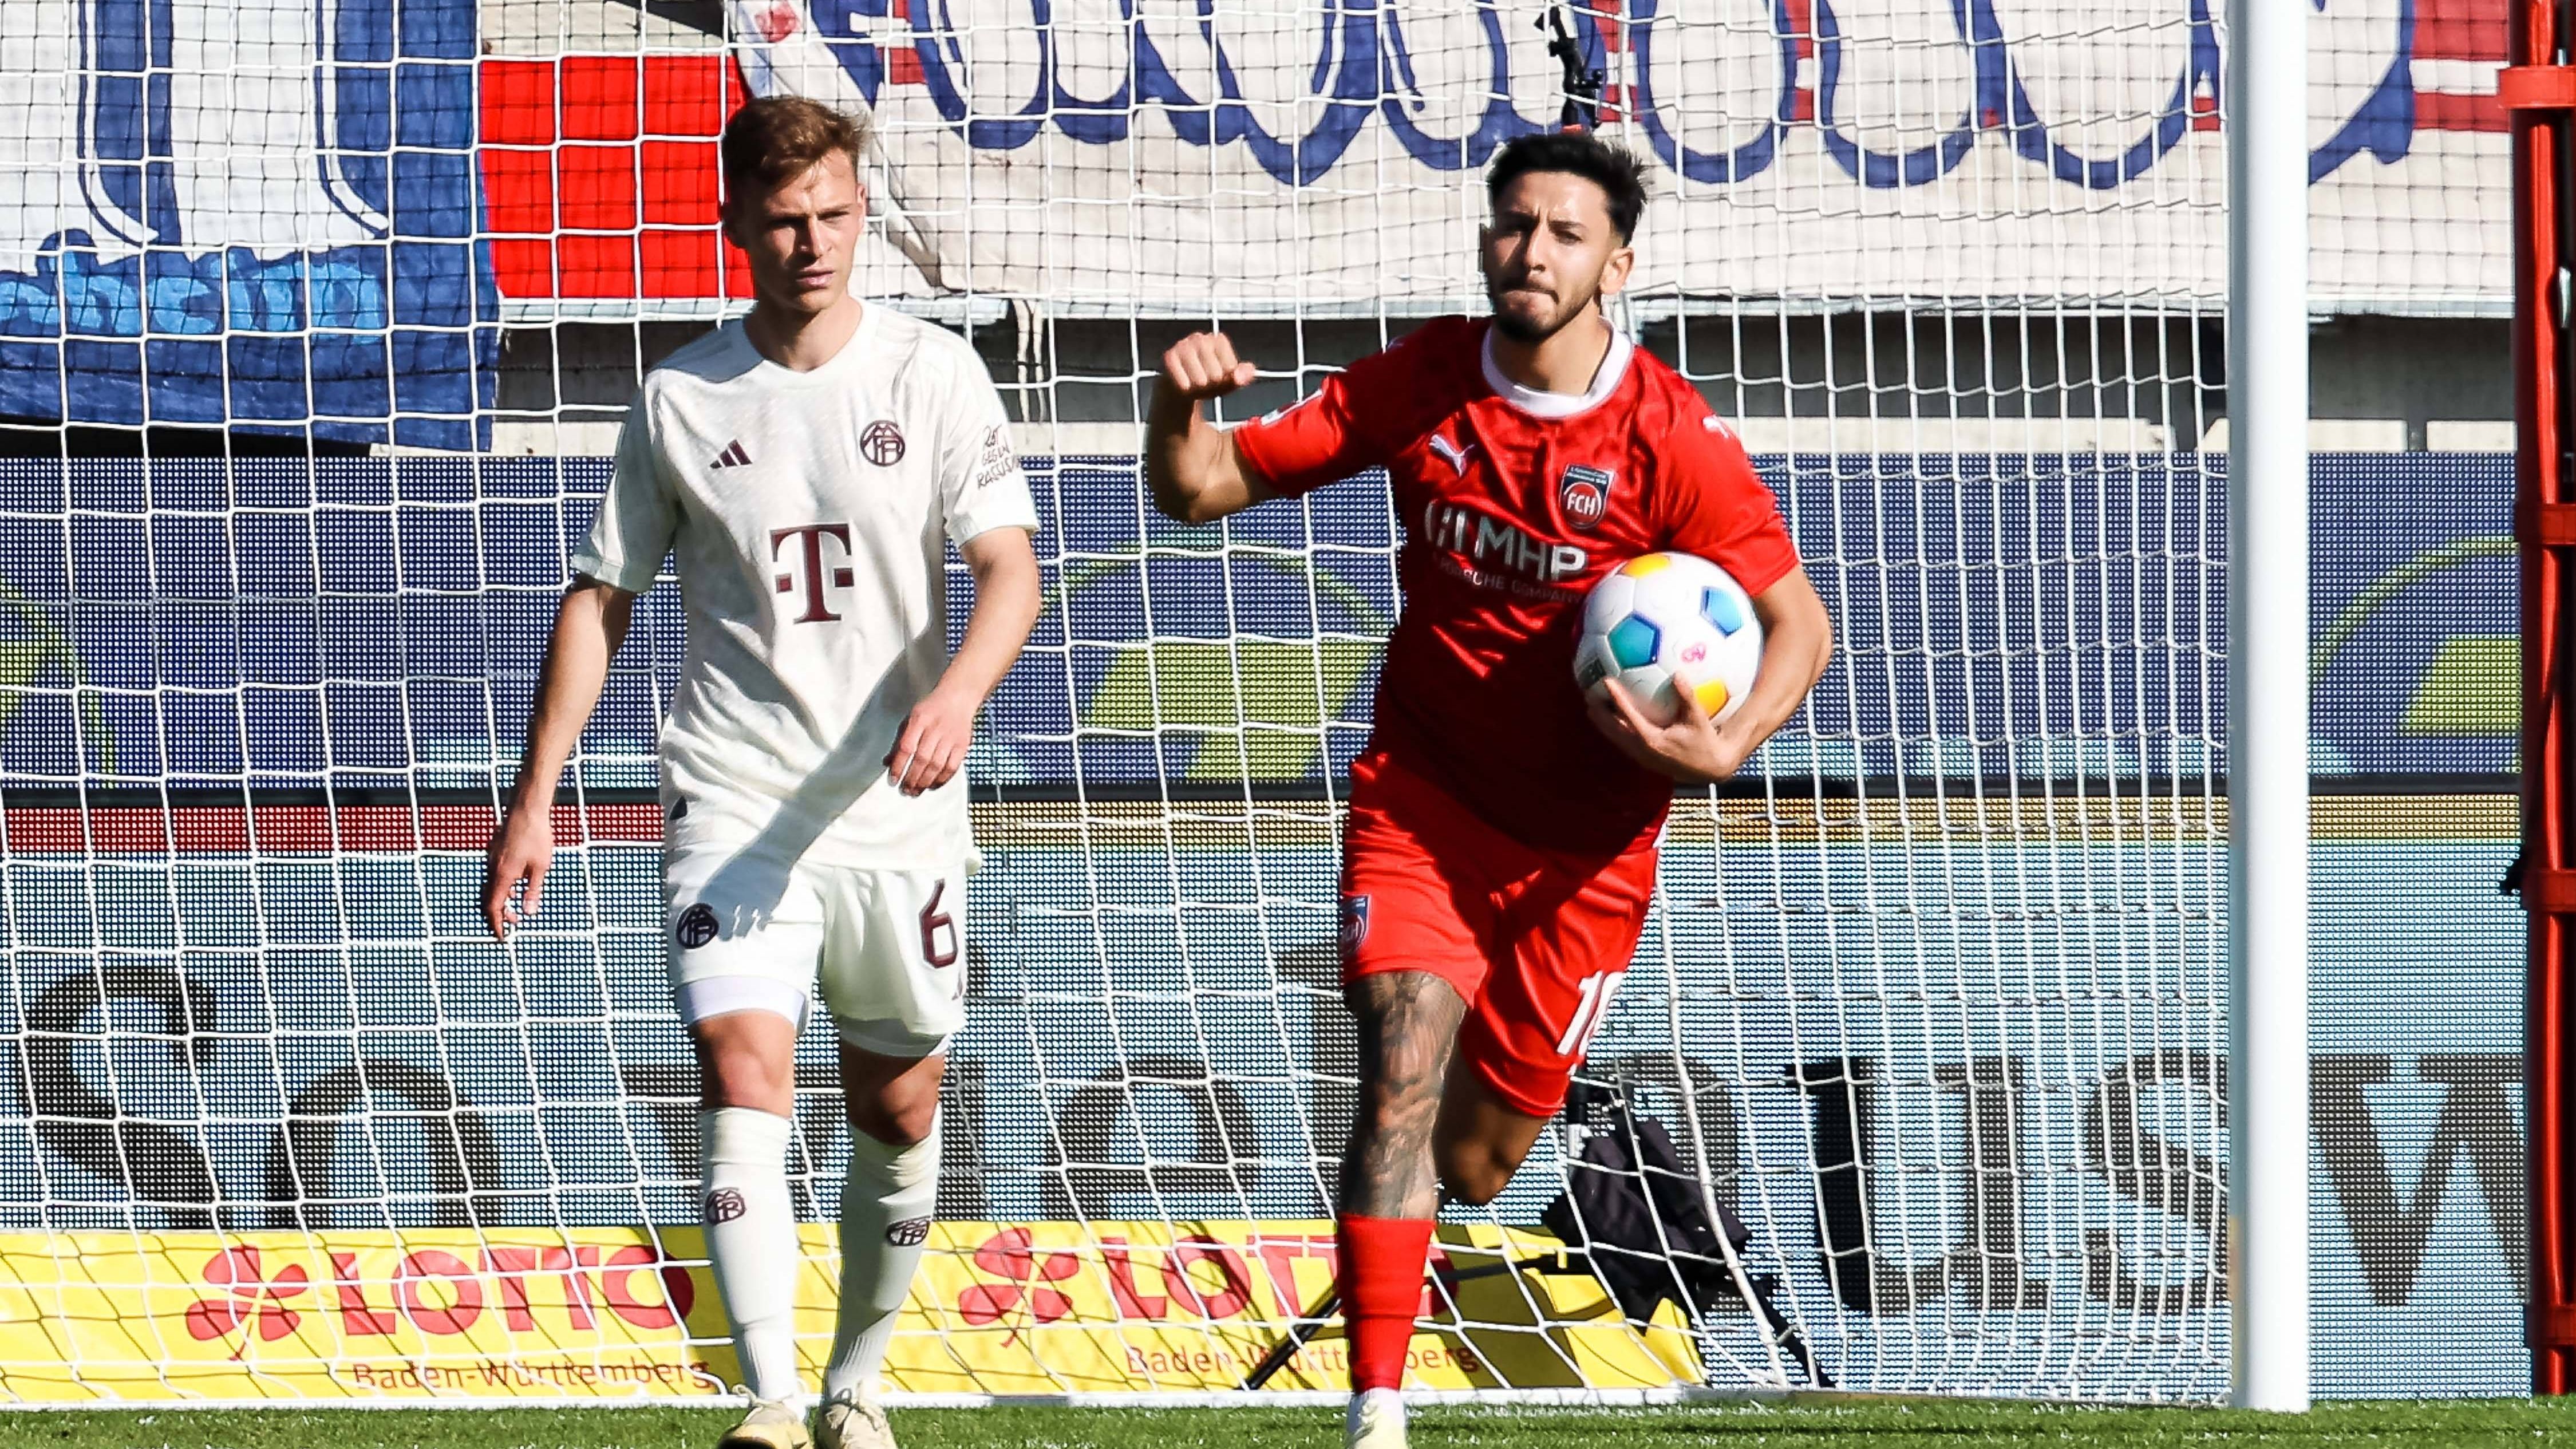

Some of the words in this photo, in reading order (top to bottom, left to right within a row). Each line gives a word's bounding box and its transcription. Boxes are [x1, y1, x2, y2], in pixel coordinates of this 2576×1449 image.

[1567, 492, 1596, 515] FCH
[769, 523, 854, 624] T
[1474, 516, 1587, 582] MHP
[919, 879, 958, 969] 6
[331, 1245, 694, 1335] LOTTO
[1100, 1234, 1459, 1318] LOT
